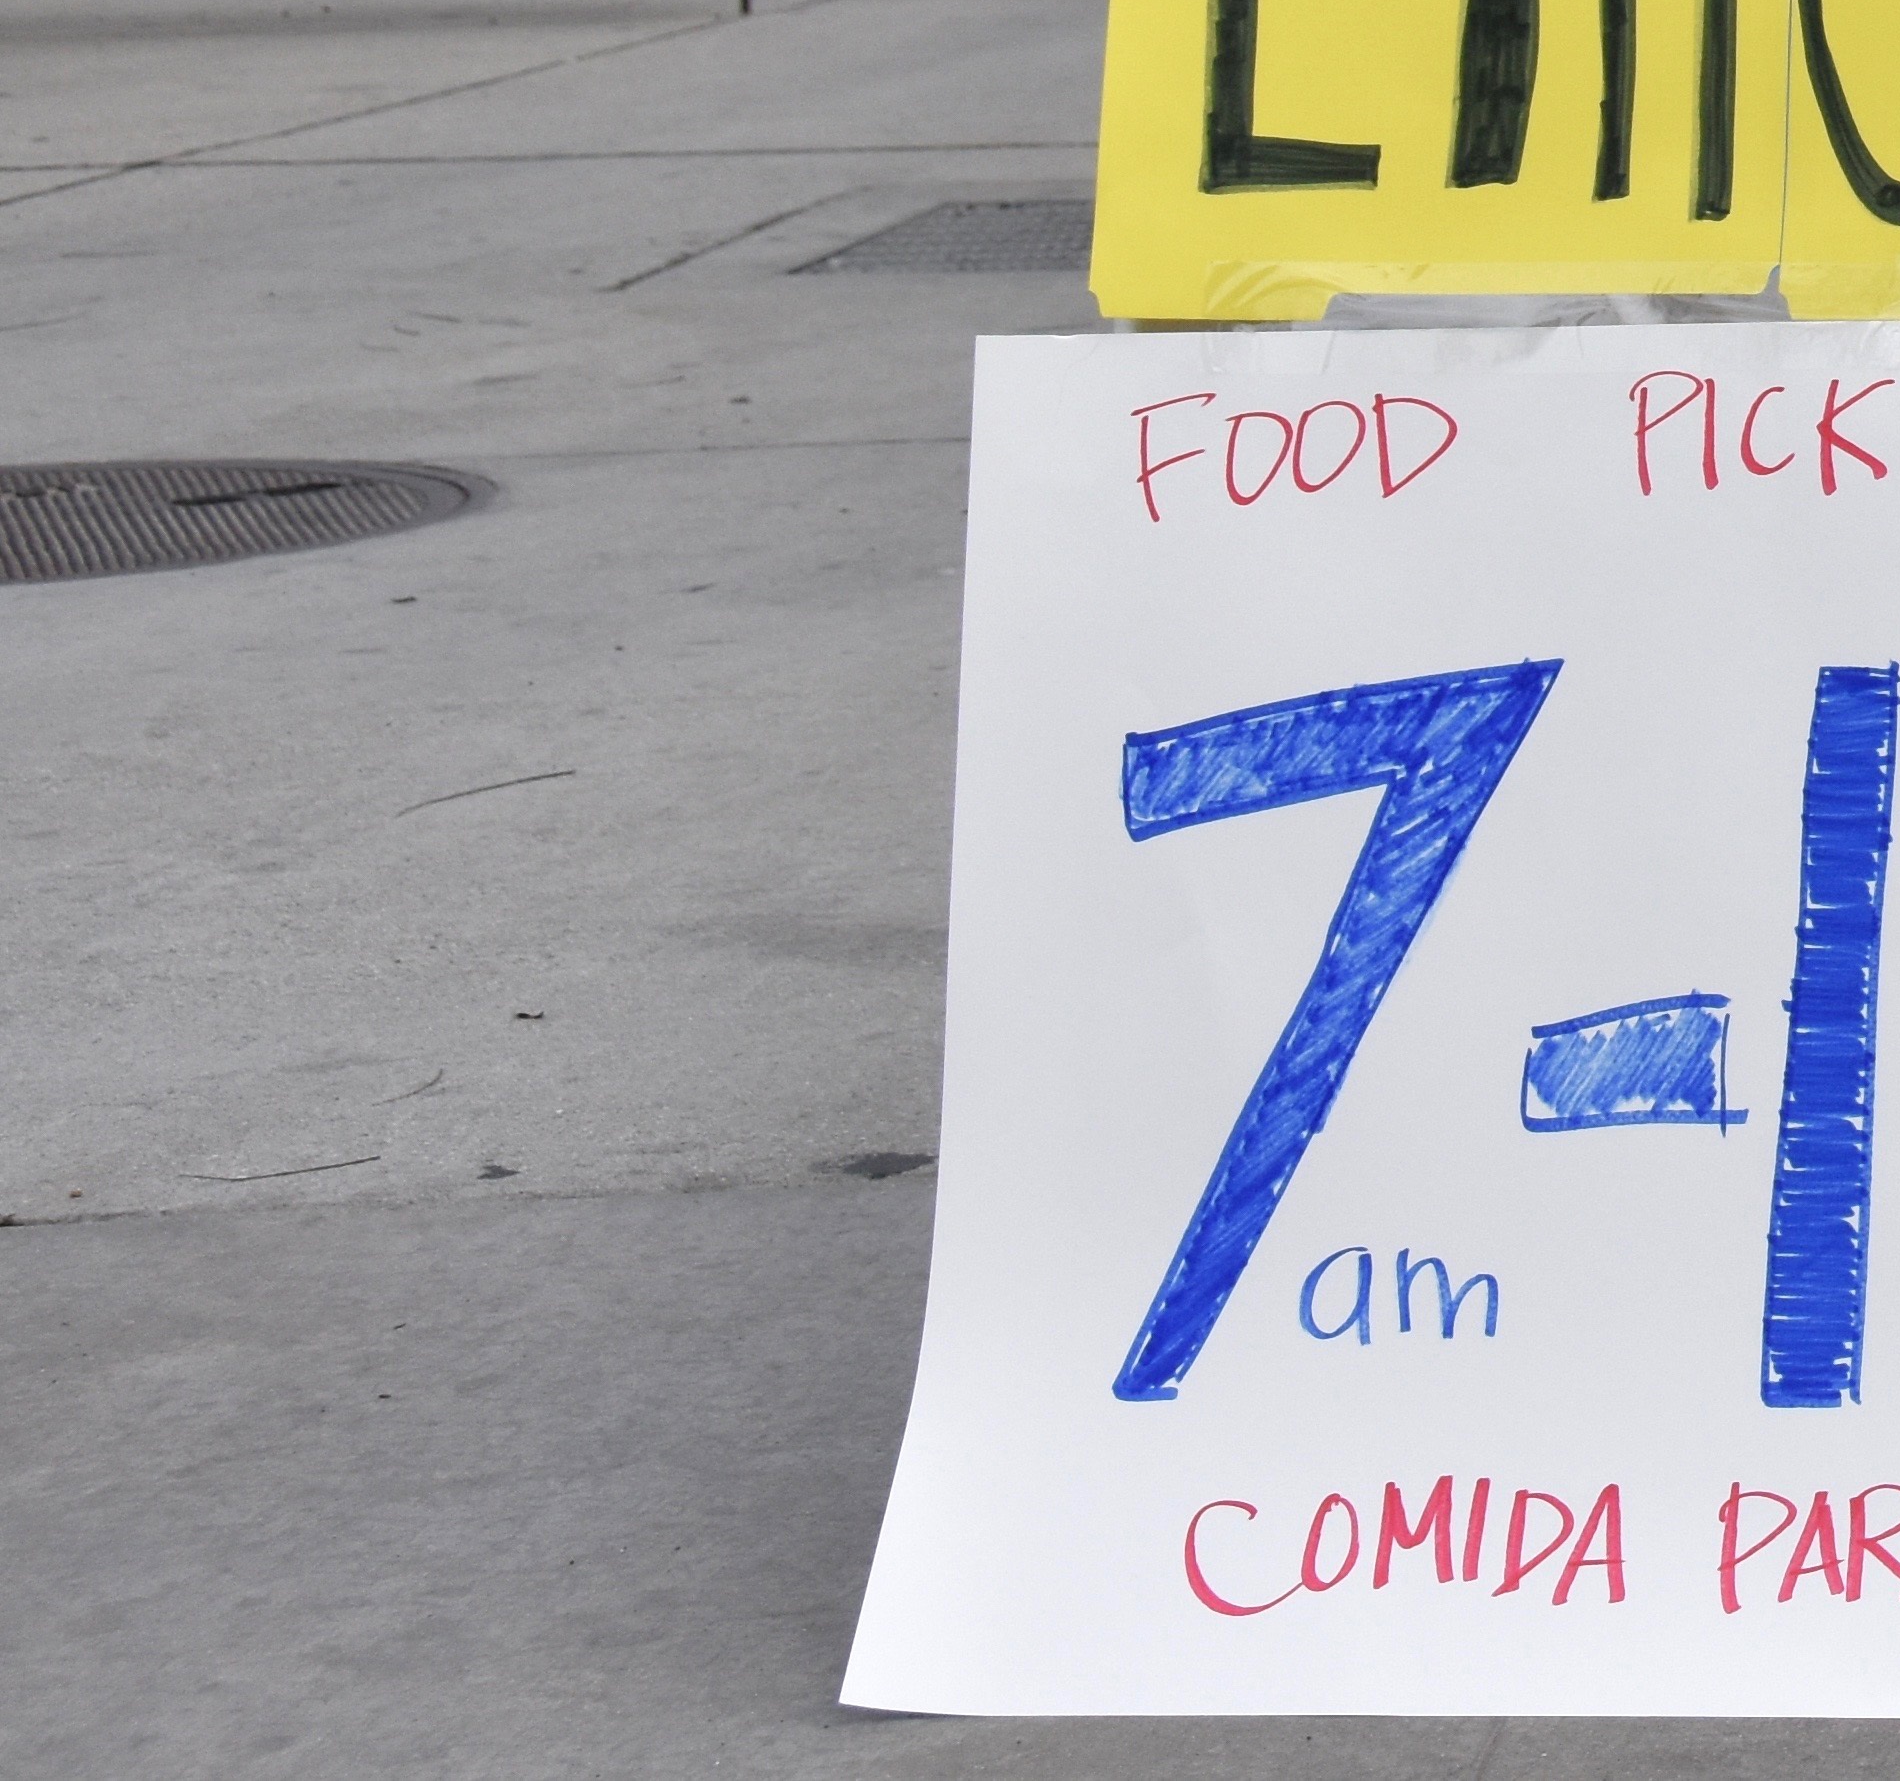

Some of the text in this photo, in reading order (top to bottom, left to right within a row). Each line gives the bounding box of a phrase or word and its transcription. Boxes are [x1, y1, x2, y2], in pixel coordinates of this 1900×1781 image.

[1130, 392, 1458, 522] FOOD
[1297, 1245, 1499, 1346] am
[1184, 1474, 1626, 1617] COMIDA
